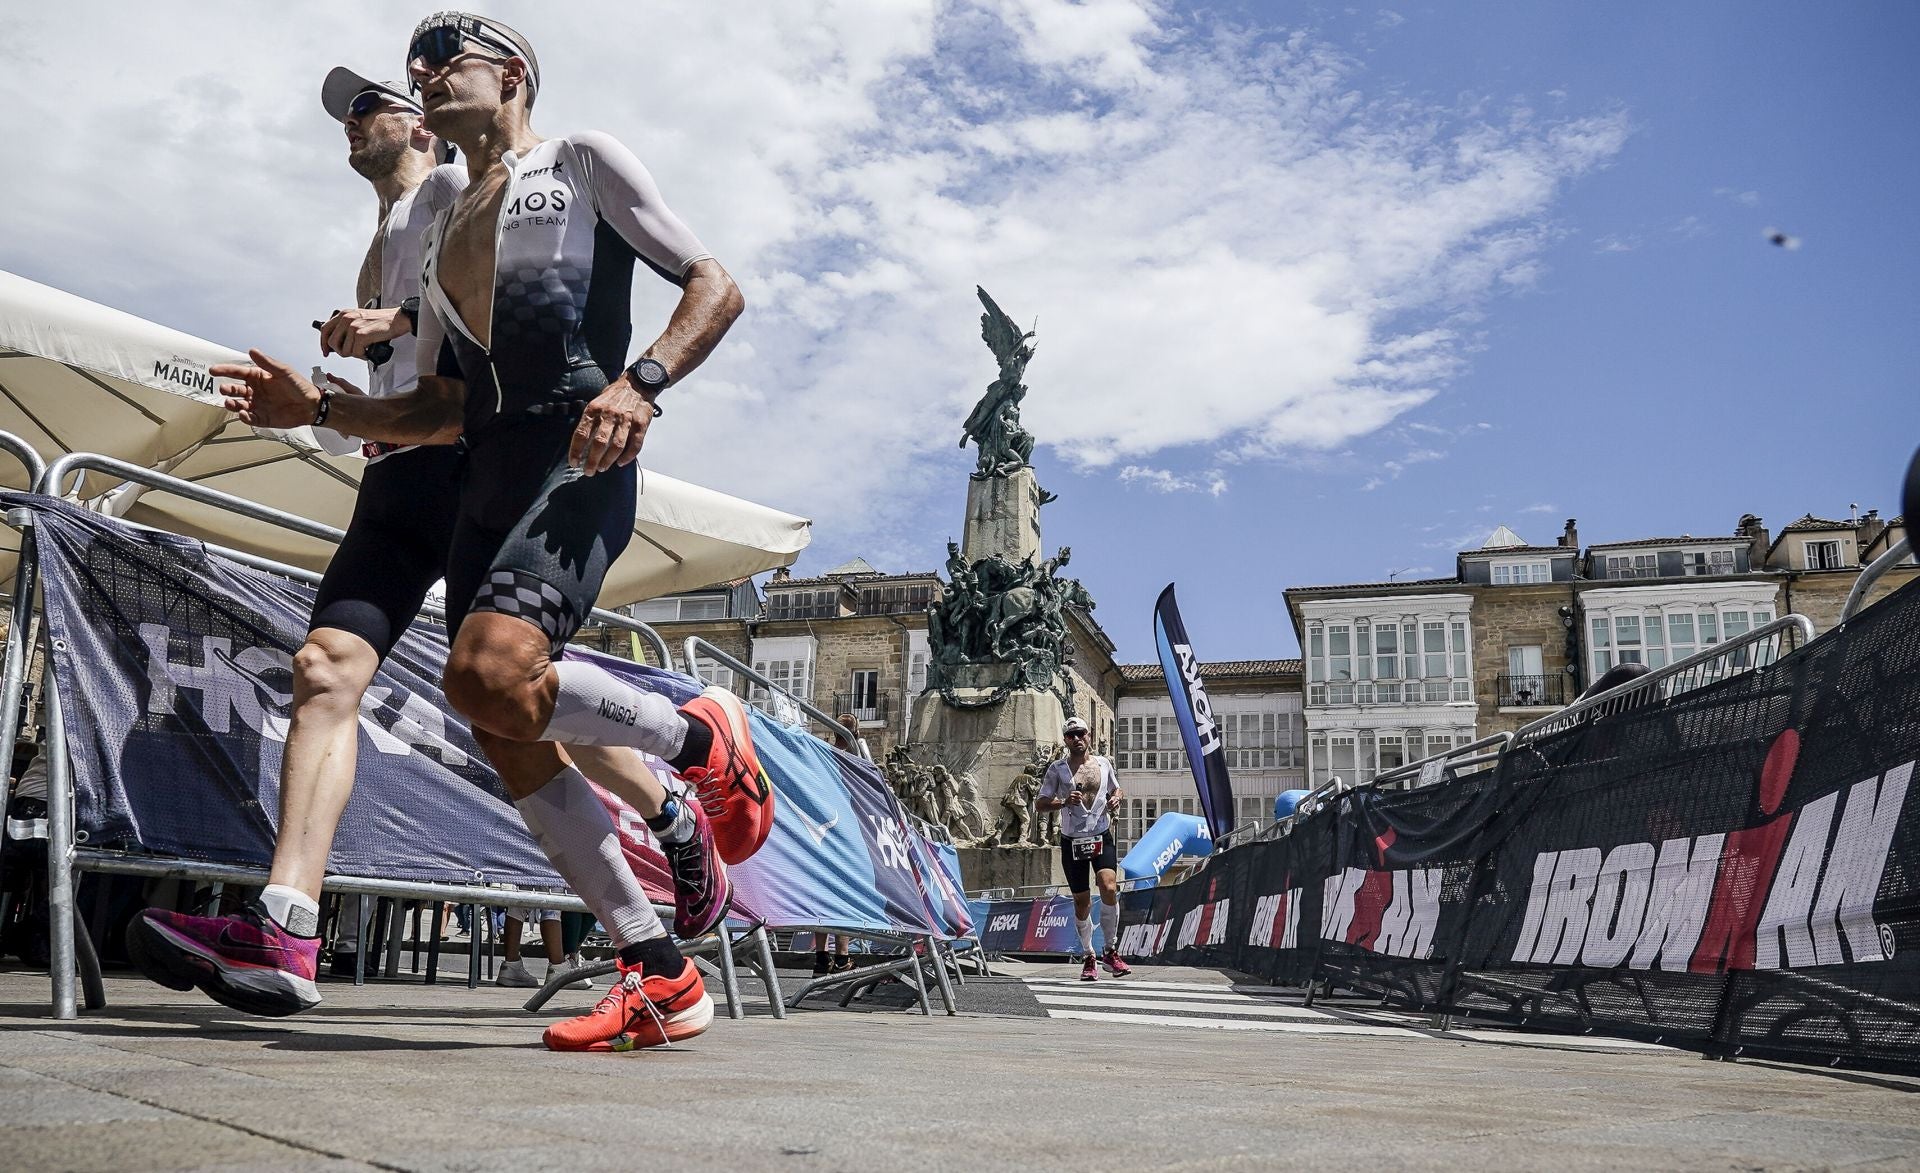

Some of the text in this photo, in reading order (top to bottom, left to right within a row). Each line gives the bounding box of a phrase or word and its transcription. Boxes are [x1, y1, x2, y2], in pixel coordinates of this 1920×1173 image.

[525, 216, 567, 227] TEAM
[154, 360, 214, 395] MAGNA
[1174, 643, 1221, 757] HOKA
[597, 697, 637, 727] FUSION
[1080, 843, 1096, 852] 540
[1152, 838, 1183, 875] HOKA
[1040, 905, 1054, 916] FY
[988, 913, 1020, 933] HOKA
[1038, 916, 1068, 928] HUMAN
[1035, 927, 1049, 938] FLY
